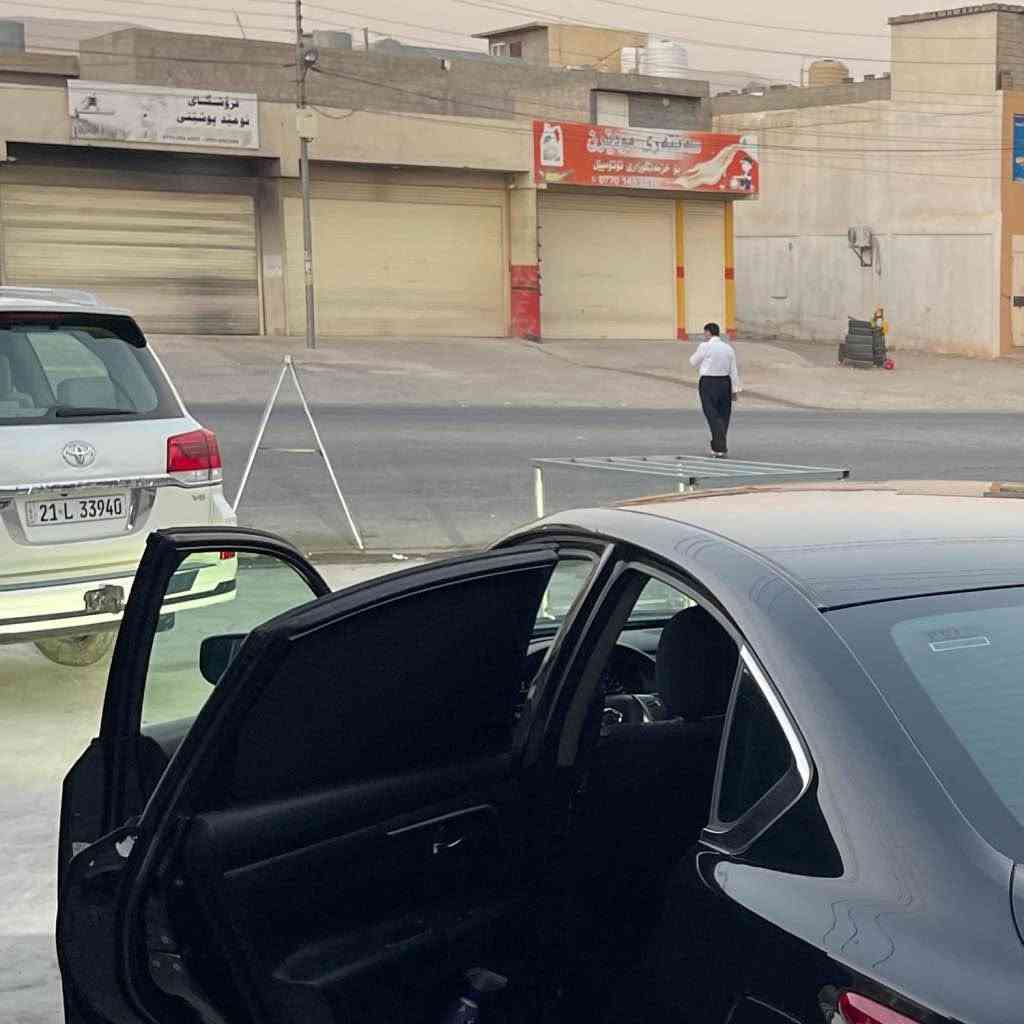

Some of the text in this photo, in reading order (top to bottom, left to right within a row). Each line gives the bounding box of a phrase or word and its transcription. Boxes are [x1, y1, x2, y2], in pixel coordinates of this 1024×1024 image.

[39, 498, 123, 522] 21 L 33940
